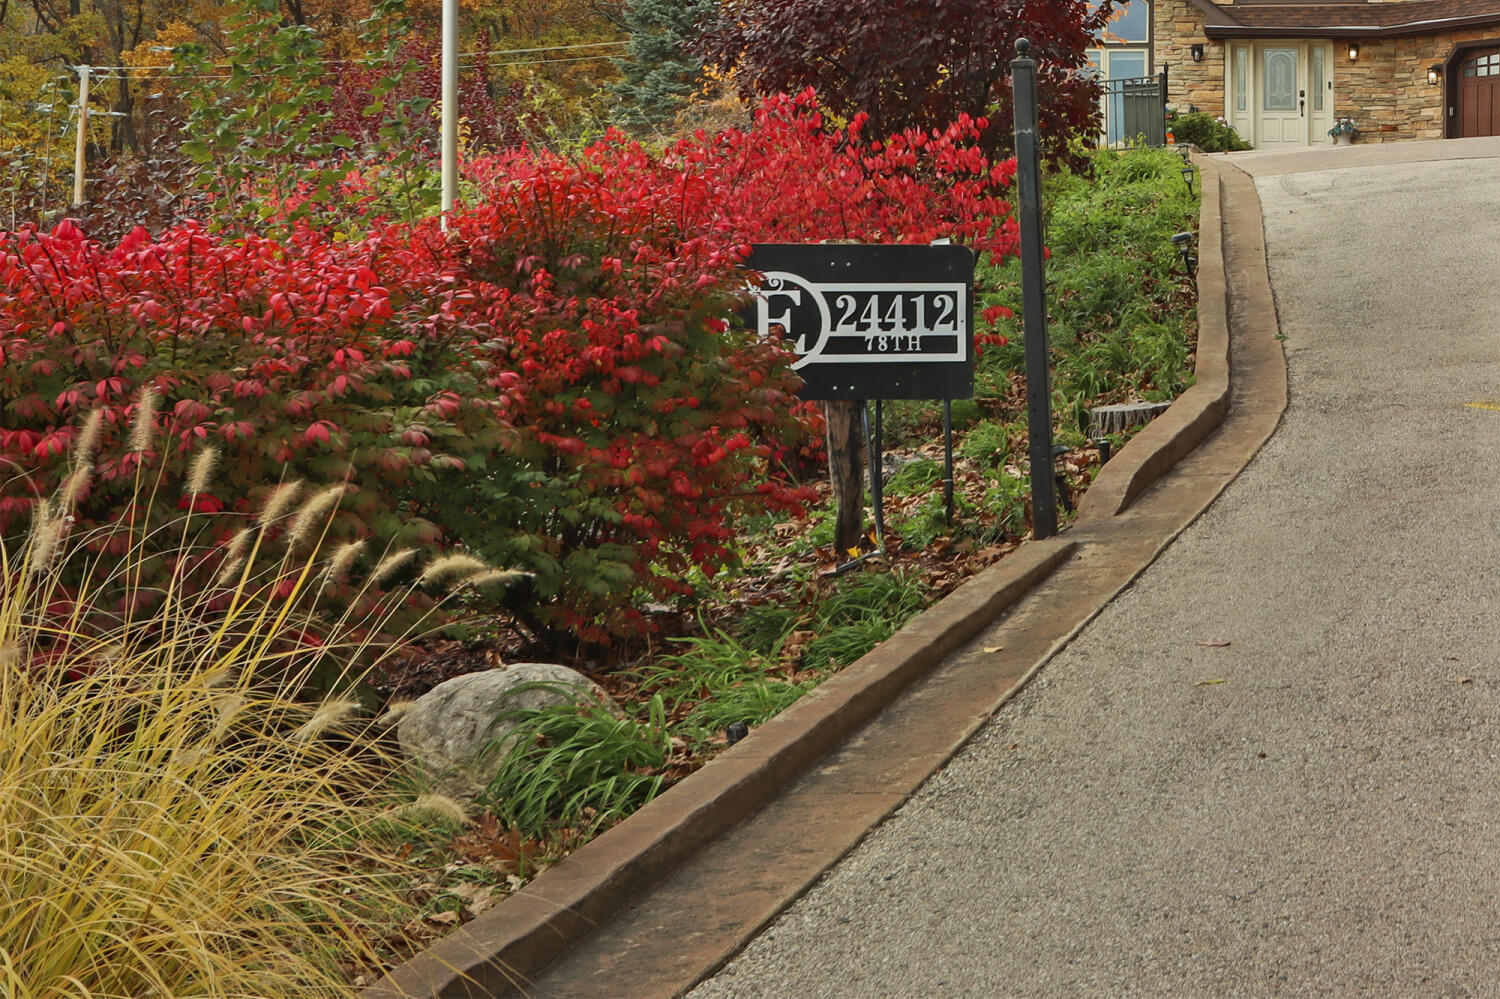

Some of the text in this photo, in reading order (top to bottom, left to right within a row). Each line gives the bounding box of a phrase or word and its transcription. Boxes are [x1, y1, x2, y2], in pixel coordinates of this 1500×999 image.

[752, 289, 807, 355] E
[835, 294, 955, 332] 24412
[864, 335, 922, 351] 78TH
